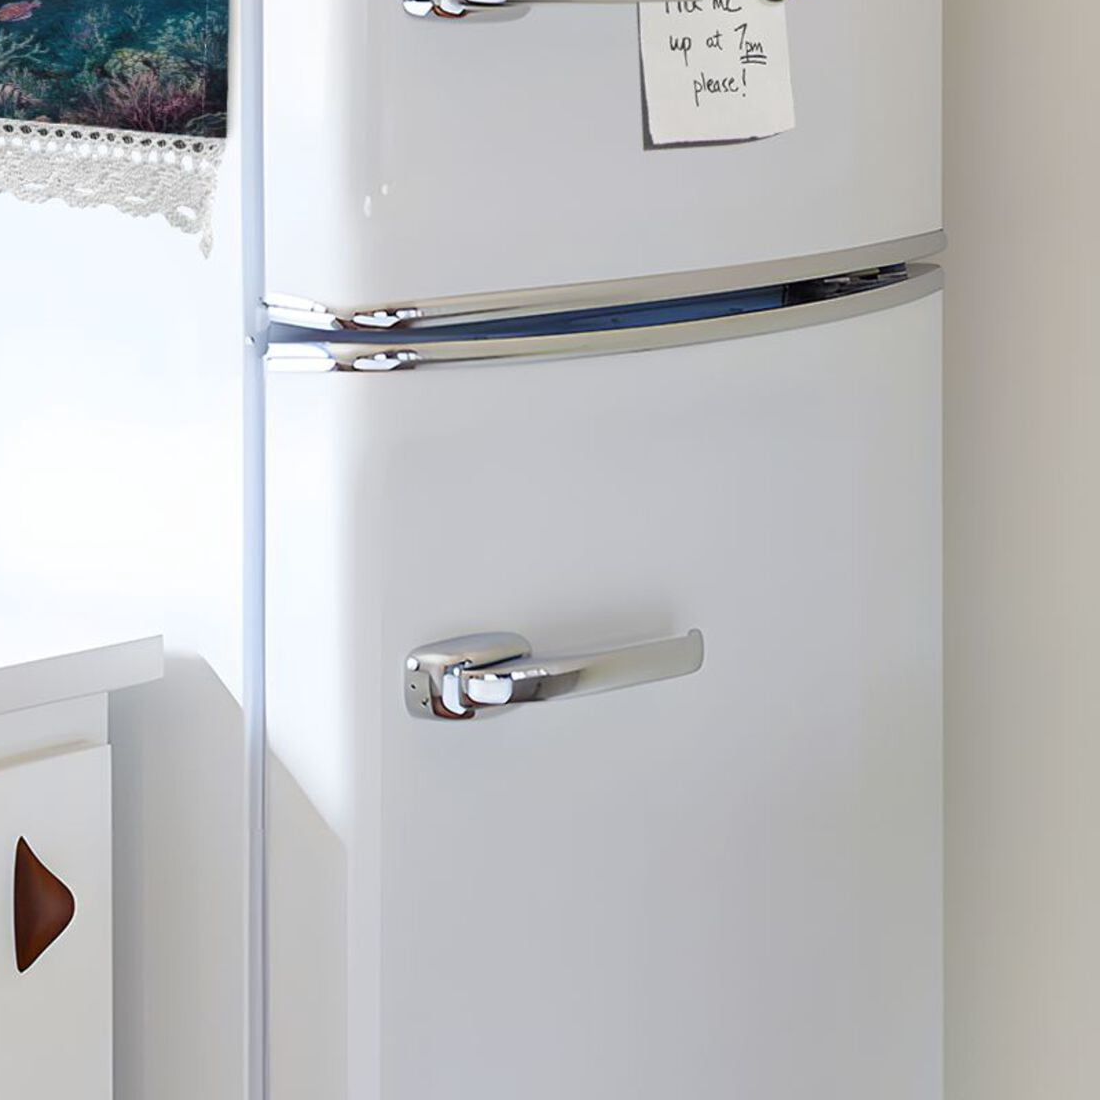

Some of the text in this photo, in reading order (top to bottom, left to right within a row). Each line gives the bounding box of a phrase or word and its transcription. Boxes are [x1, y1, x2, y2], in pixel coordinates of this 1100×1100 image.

[669, 35, 692, 67] up
[706, 30, 723, 51] at
[693, 68, 747, 107] please!
